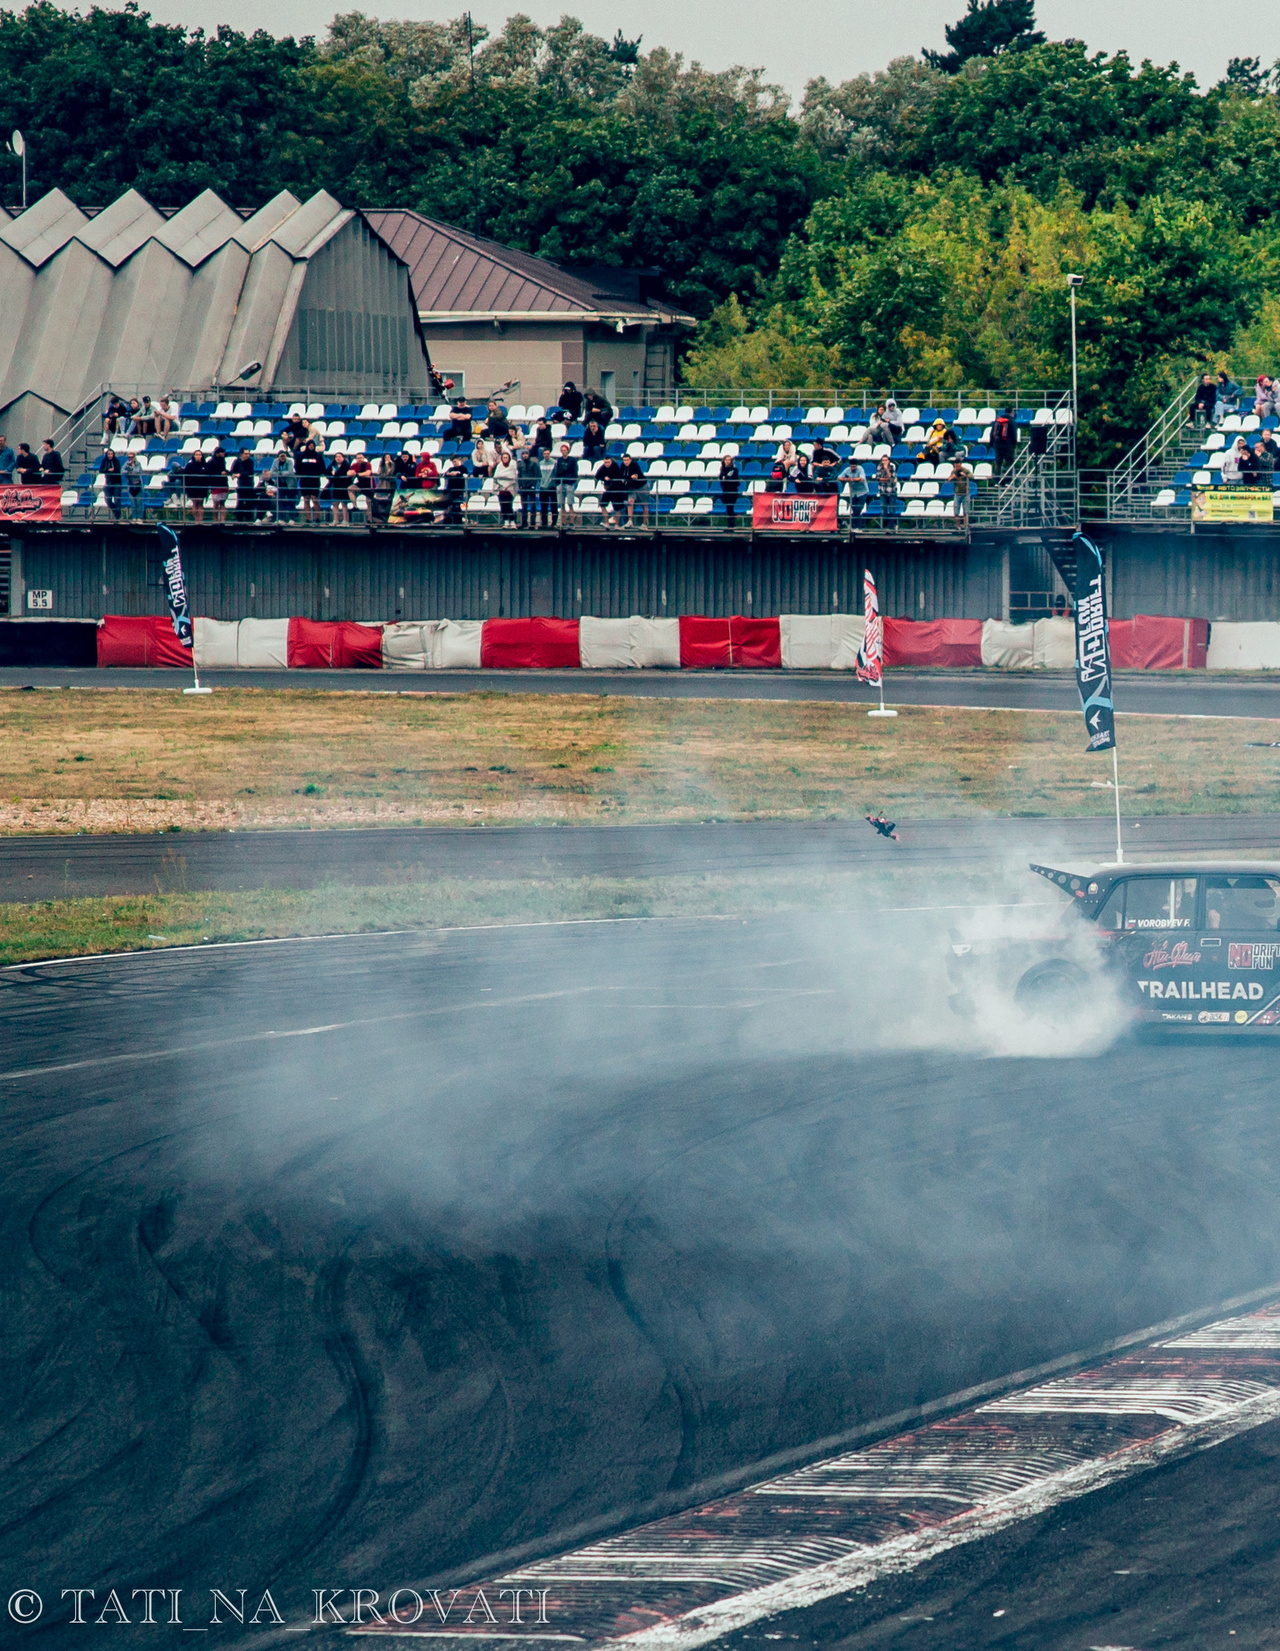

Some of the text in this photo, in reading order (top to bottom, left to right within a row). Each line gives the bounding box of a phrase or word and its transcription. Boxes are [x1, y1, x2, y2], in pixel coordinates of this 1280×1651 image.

[773, 499, 818, 523] NO DRIFT
[793, 511, 810, 523] FUN
[32, 599, 48, 607] 5.5
[1137, 919, 1190, 928] VOROBYEV F.
[1228, 943, 1253, 970] NO
[1252, 957, 1274, 970] FUN
[1136, 980, 1264, 1000] TRAILHEAD
